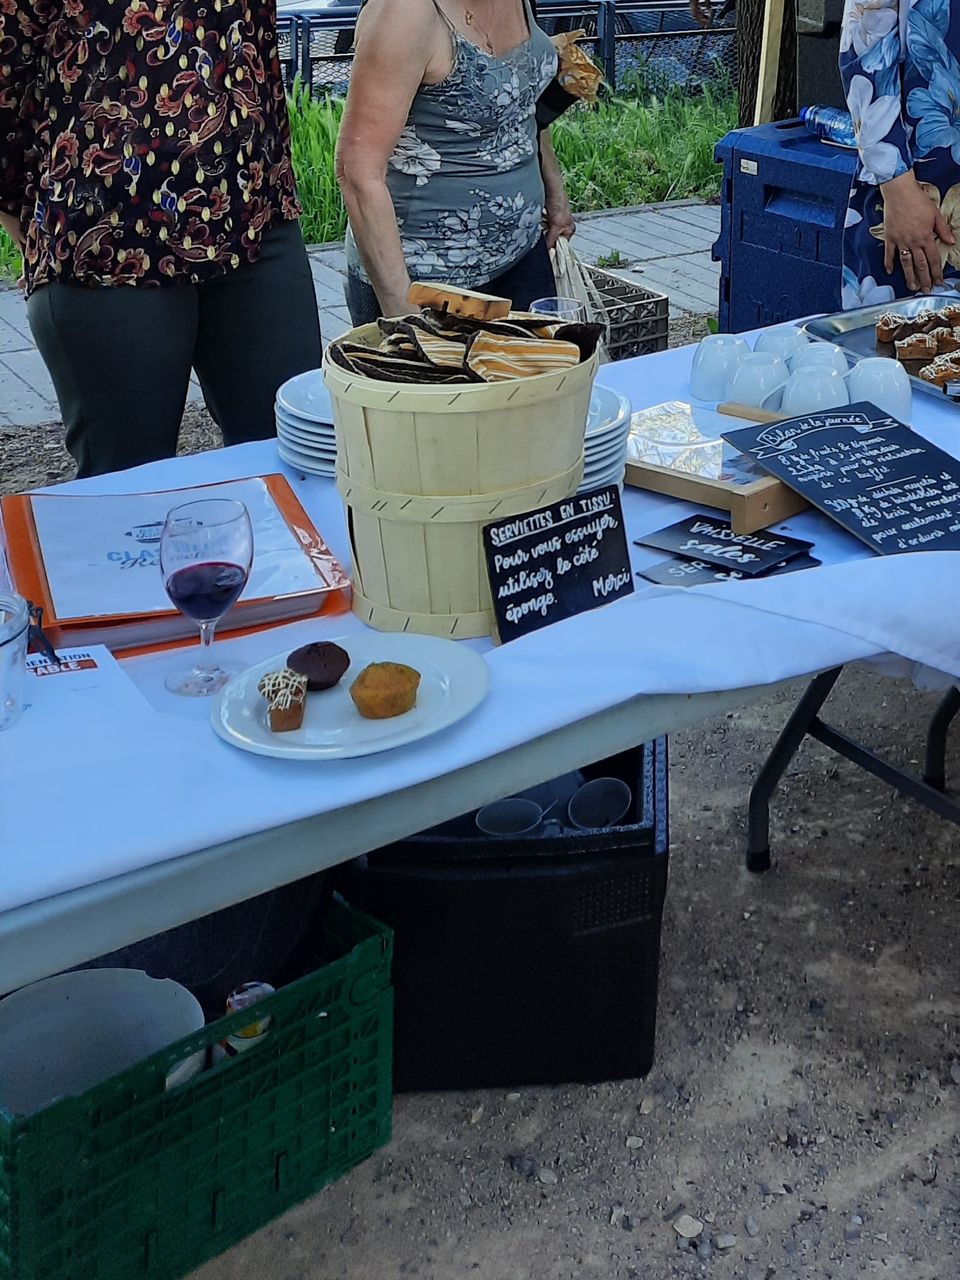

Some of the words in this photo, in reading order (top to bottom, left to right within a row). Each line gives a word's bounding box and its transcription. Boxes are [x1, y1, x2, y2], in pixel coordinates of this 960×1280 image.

[763, 427, 800, 445] Bilan
[800, 421, 811, 430] de
[812, 418, 823, 427] la
[490, 511, 553, 545] SERVIETTES
[560, 502, 575, 518] EN
[872, 527, 898, 544] pour
[494, 549, 530, 573] Pour
[531, 536, 562, 559] vous
[565, 514, 618, 543] essuyer,
[679, 539, 760, 564] sales
[498, 566, 553, 598] utilisez
[556, 557, 572, 575] le
[573, 540, 599, 566] côté
[592, 567, 630, 597] Merci
[505, 592, 558, 623] éponge.
